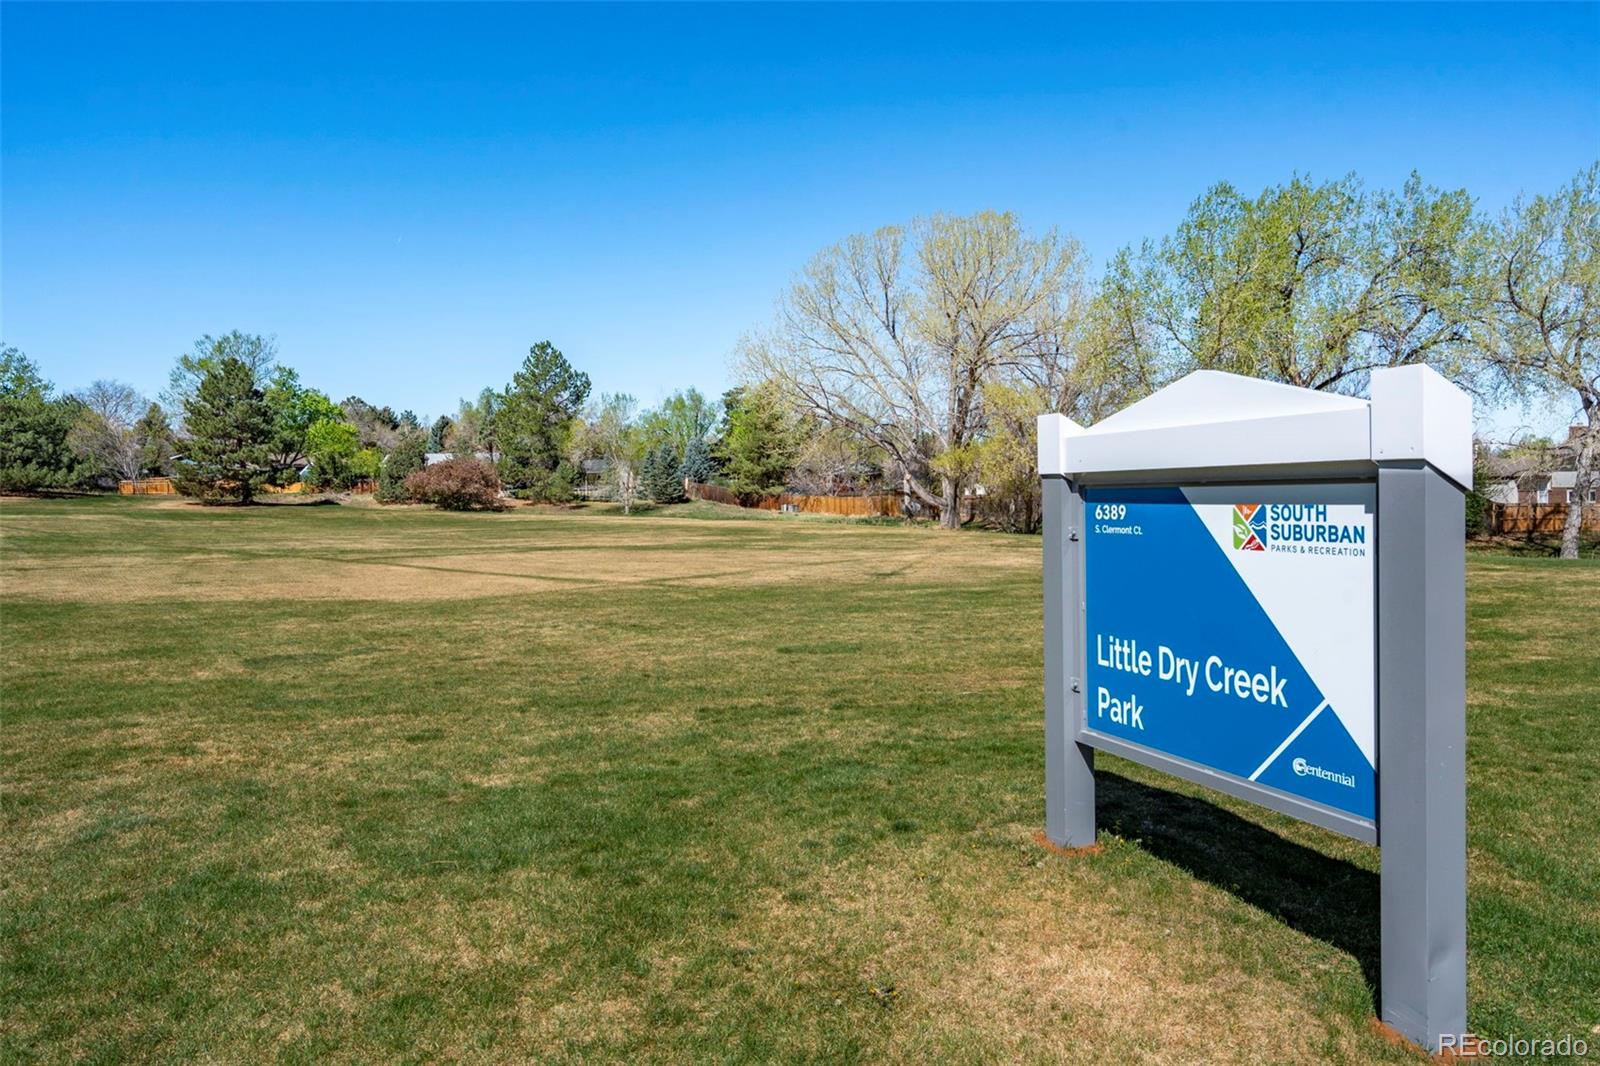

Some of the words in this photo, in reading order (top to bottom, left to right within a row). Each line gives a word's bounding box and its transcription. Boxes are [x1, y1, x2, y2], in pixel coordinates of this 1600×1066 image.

[1095, 504, 1126, 520] 6389
[1270, 504, 1327, 522] SOUTH
[1095, 524, 1101, 533] S.
[1102, 525, 1132, 535] Clermont
[1133, 526, 1143, 535] Ct.
[1270, 524, 1365, 544] SUBURBAN
[1271, 545, 1298, 554] PARKS
[1300, 546, 1306, 554] &
[1308, 546, 1366, 557] RECREATION
[1097, 634, 1152, 676] Little
[1158, 646, 1199, 696] Dry
[1205, 655, 1289, 708] Creek
[1098, 687, 1145, 731] Park
[1292, 757, 1356, 788] Centennial
